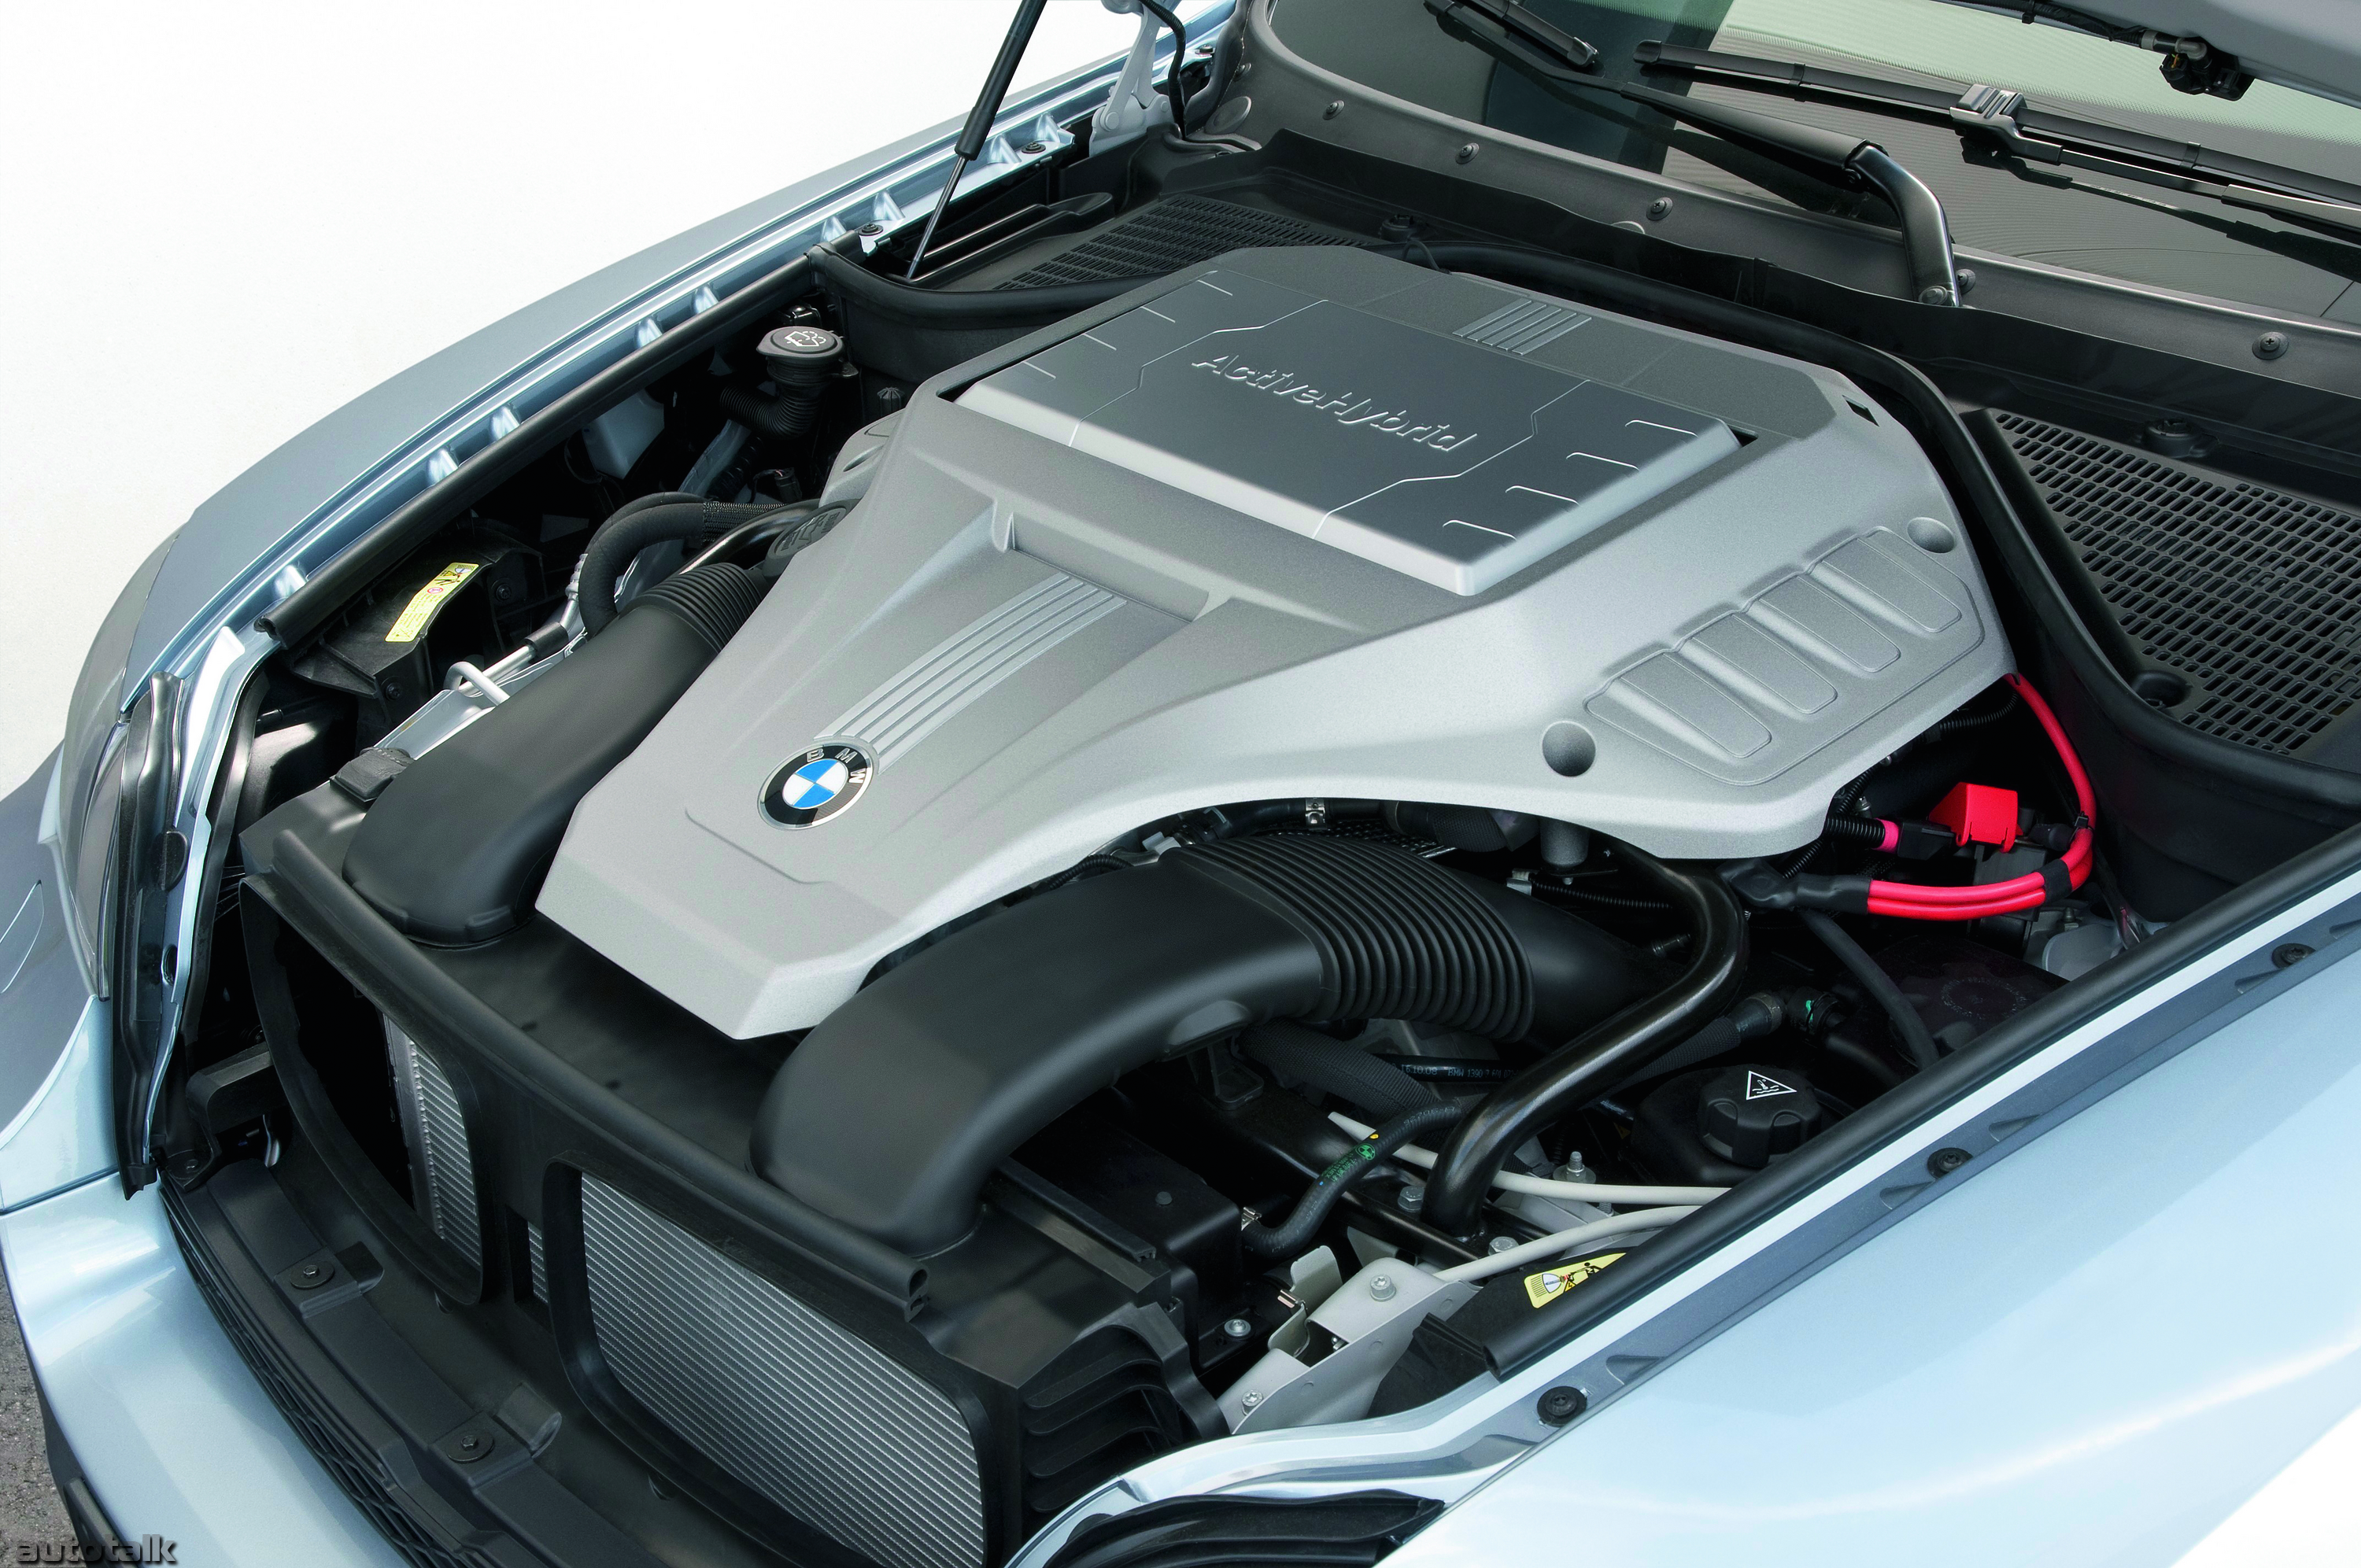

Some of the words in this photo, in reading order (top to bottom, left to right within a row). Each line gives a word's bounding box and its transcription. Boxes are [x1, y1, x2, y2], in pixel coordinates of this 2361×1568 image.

[1191, 353, 1478, 452] ActiveHybrid
[806, 747, 867, 784] BMW
[1447, 1066, 1465, 1077] BMW
